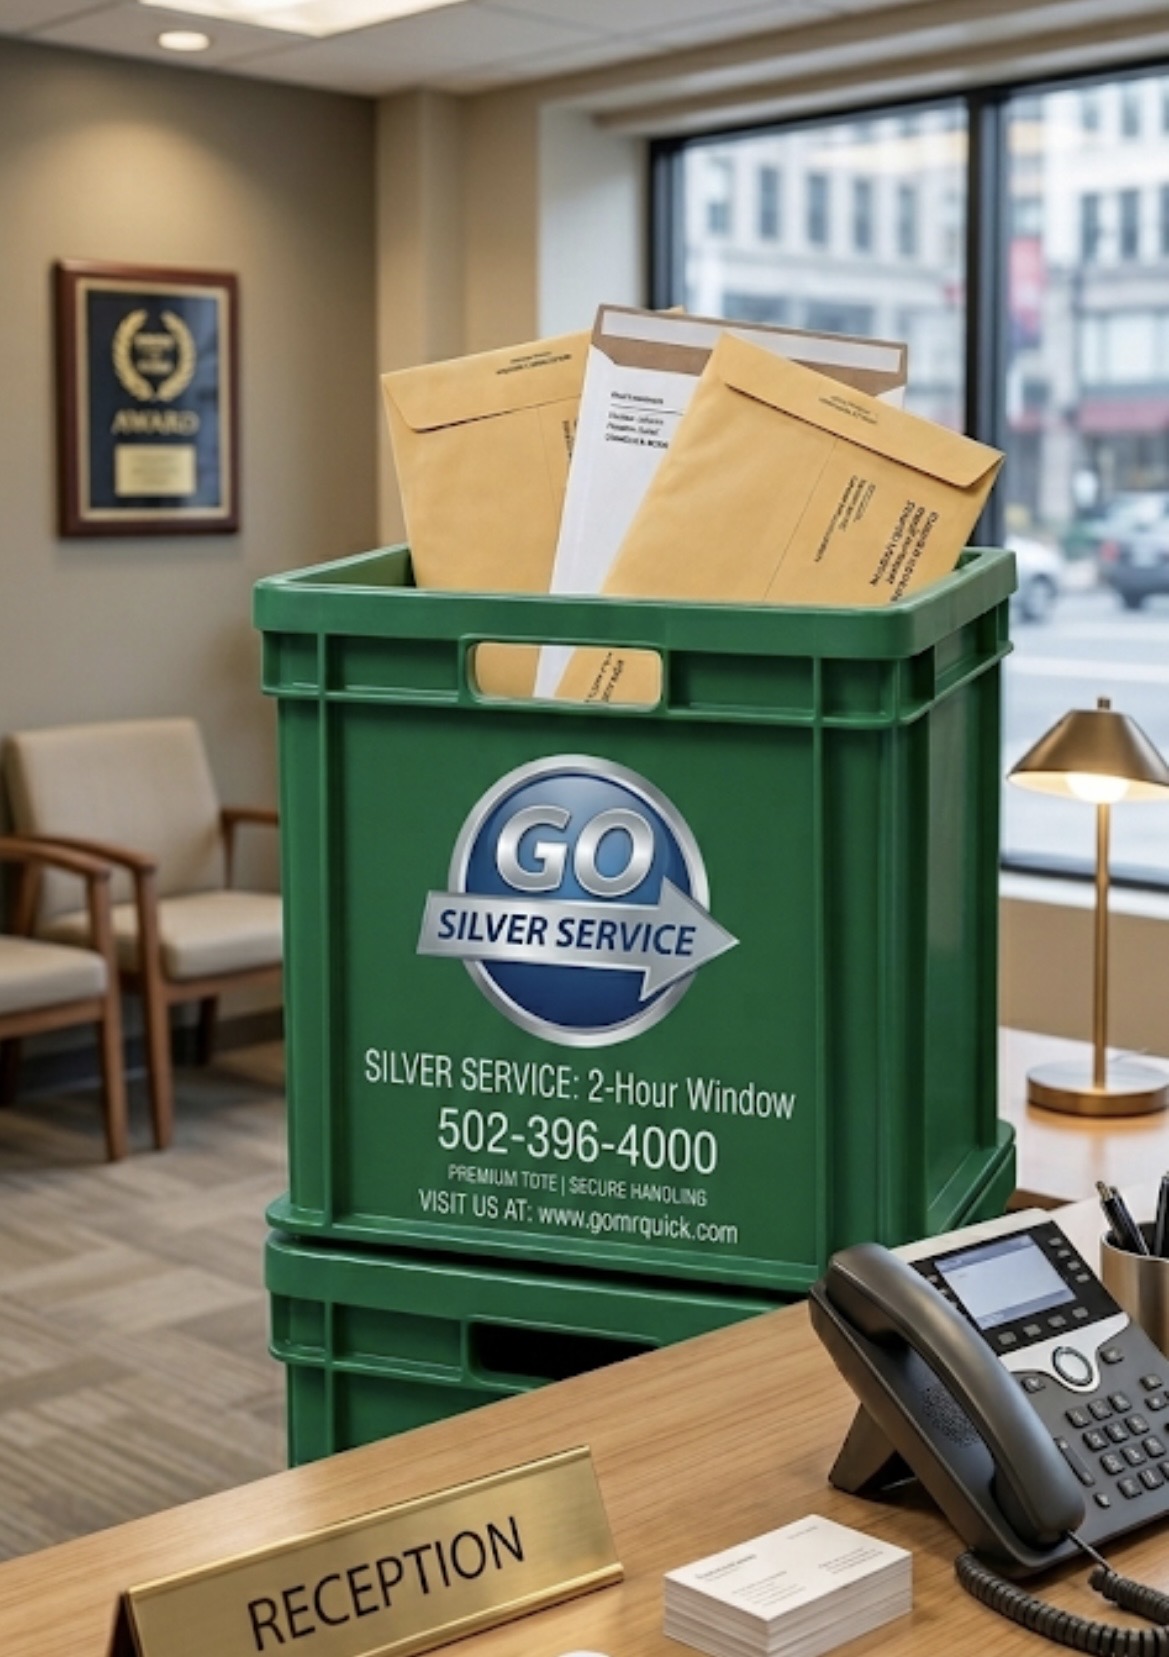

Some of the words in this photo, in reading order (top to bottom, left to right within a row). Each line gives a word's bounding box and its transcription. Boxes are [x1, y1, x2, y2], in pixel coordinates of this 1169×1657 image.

[496, 806, 655, 898] GO
[438, 910, 548, 945] SILVER
[556, 919, 696, 956] SERVICE
[365, 1048, 453, 1089] SILVER
[461, 1057, 580, 1099] SERVICE:
[588, 1069, 678, 1109] 2-Hour
[687, 1078, 796, 1119] Window
[438, 1108, 718, 1174] 502-396-4000
[419, 1189, 466, 1215] VISIT
[472, 1196, 498, 1218] US
[504, 1199, 533, 1222] AT:
[538, 1205, 739, 1244] www.gomrquick.com
[448, 1164, 518, 1187] PREMIUM
[521, 1171, 558, 1192] TOTE
[569, 1176, 627, 1199] SECURE
[631, 1182, 708, 1207] HANDLING
[247, 1516, 525, 1650] RECEPTION
